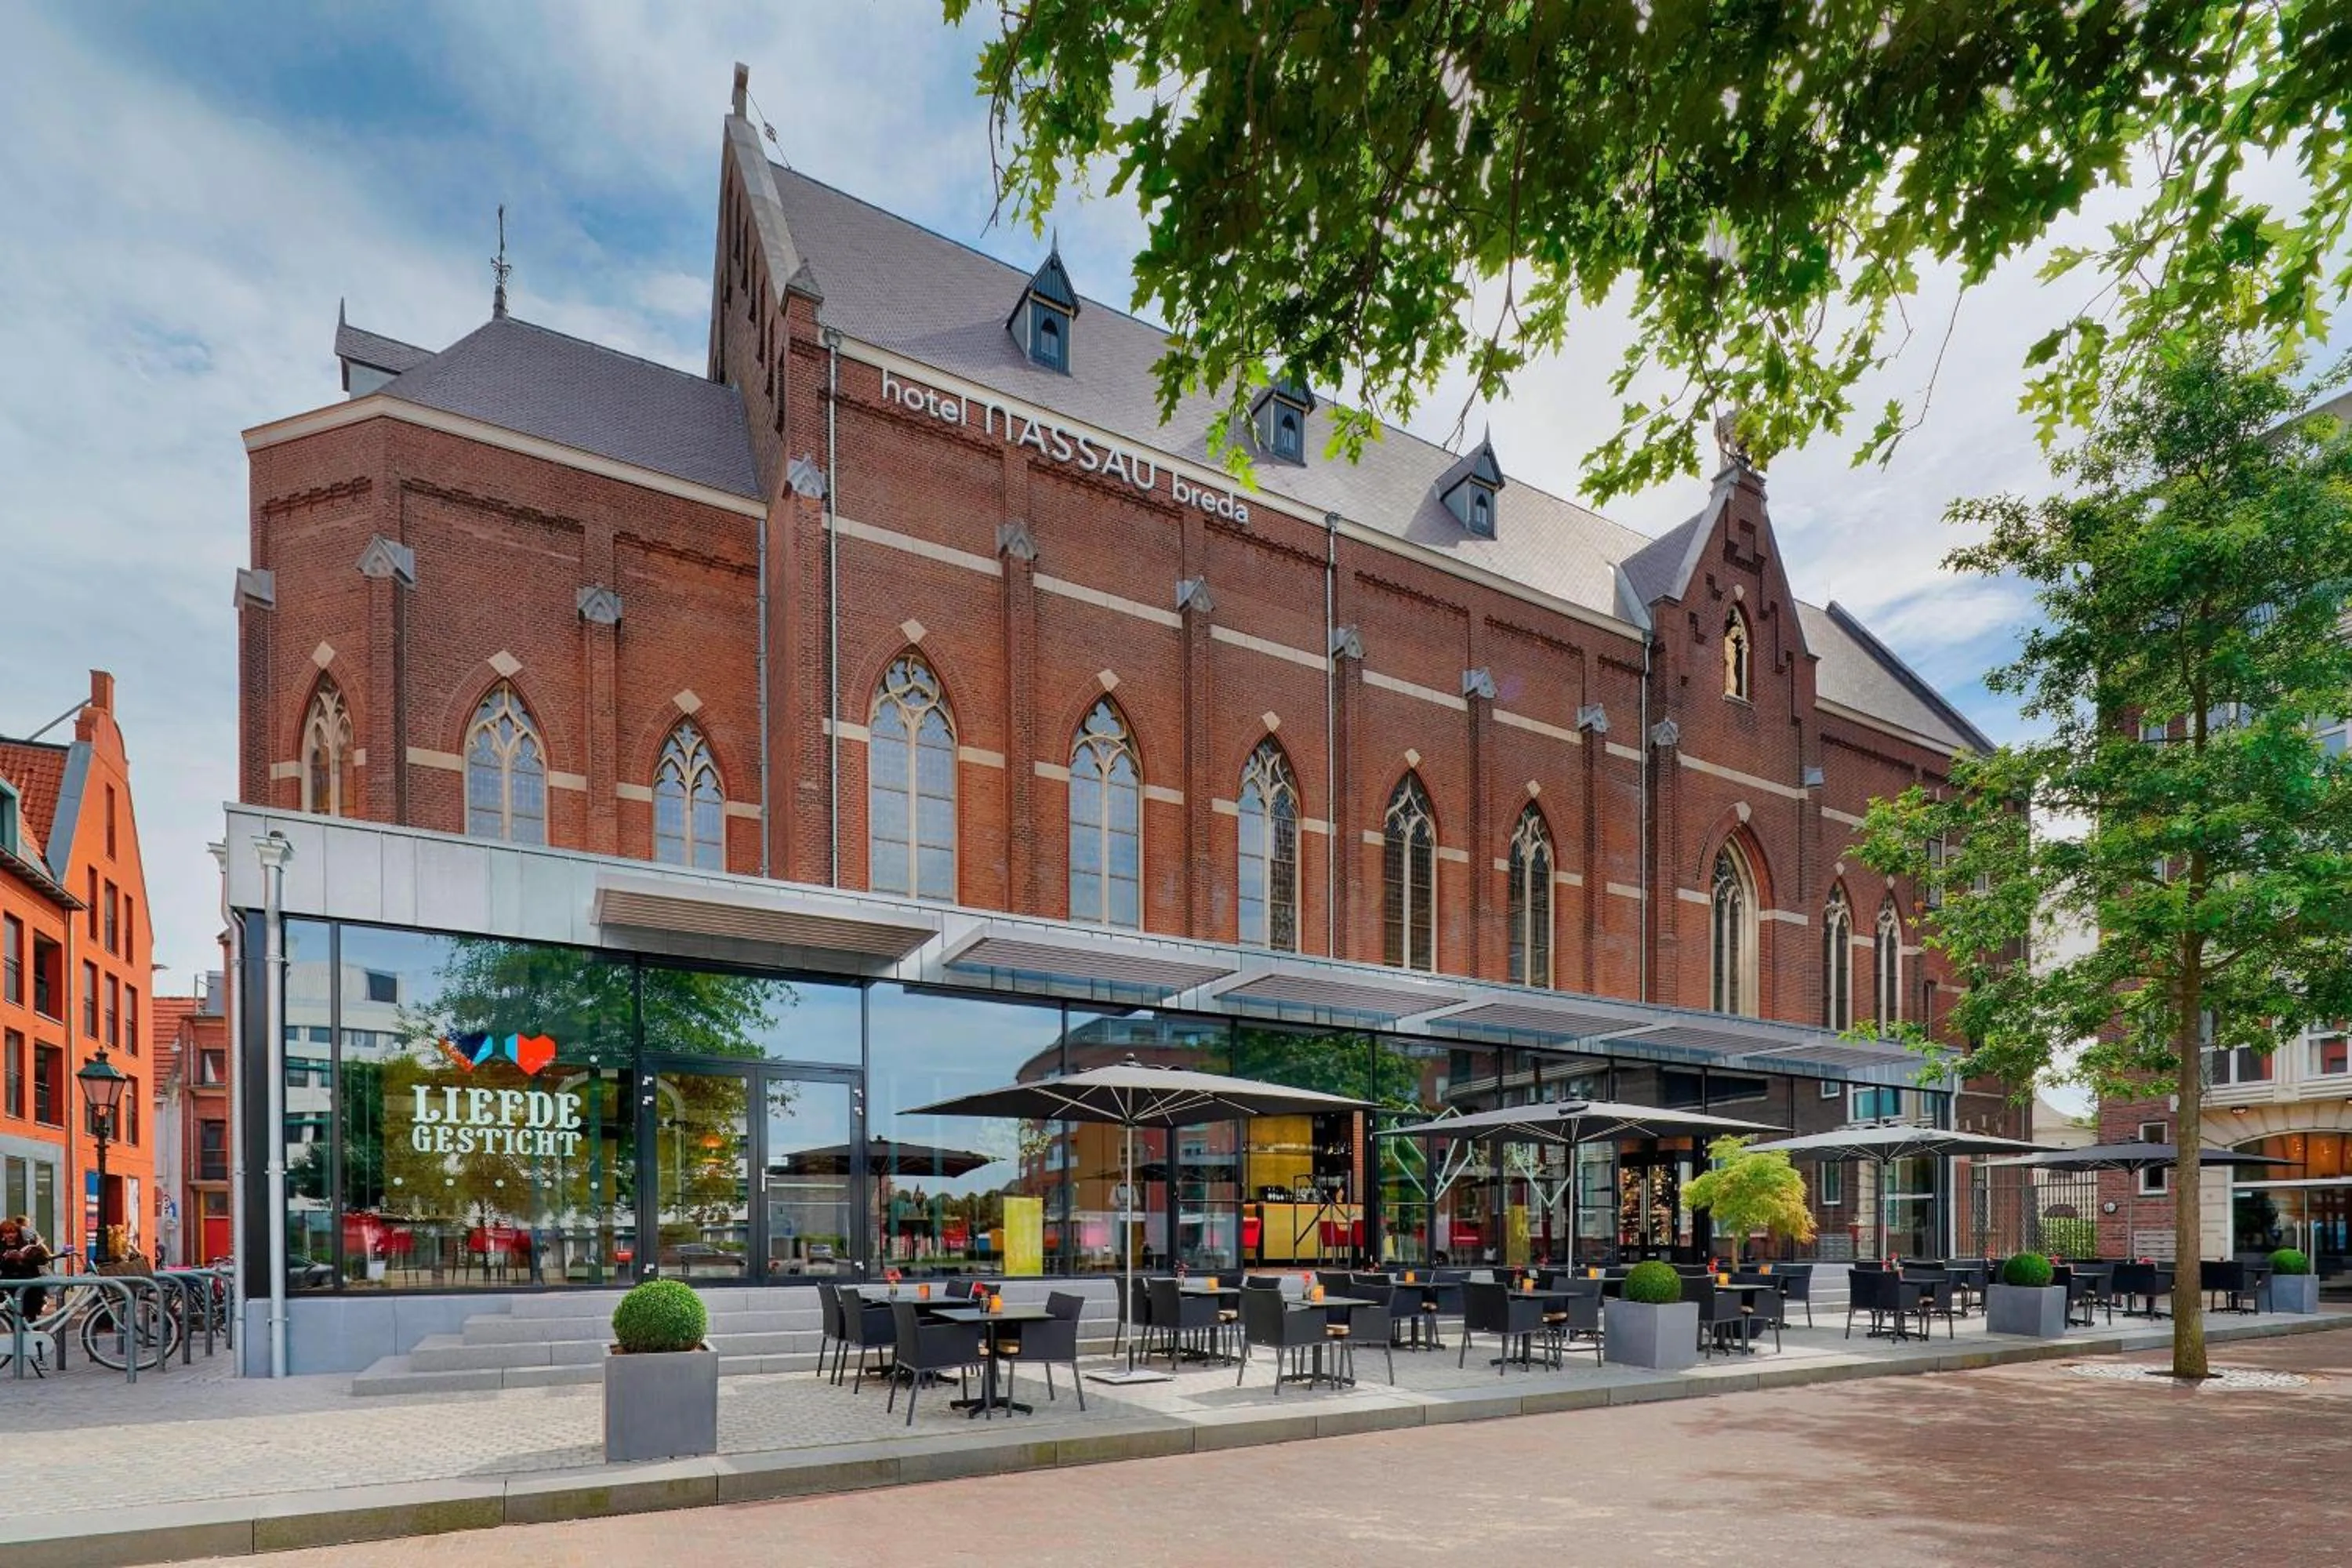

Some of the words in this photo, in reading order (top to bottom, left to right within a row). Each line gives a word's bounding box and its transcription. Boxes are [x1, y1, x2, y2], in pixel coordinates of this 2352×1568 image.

[882, 367, 967, 426] hotel
[1172, 471, 1249, 524] breda
[412, 1084, 582, 1129] LIEFDE
[412, 1126, 583, 1156] GESTICHT
